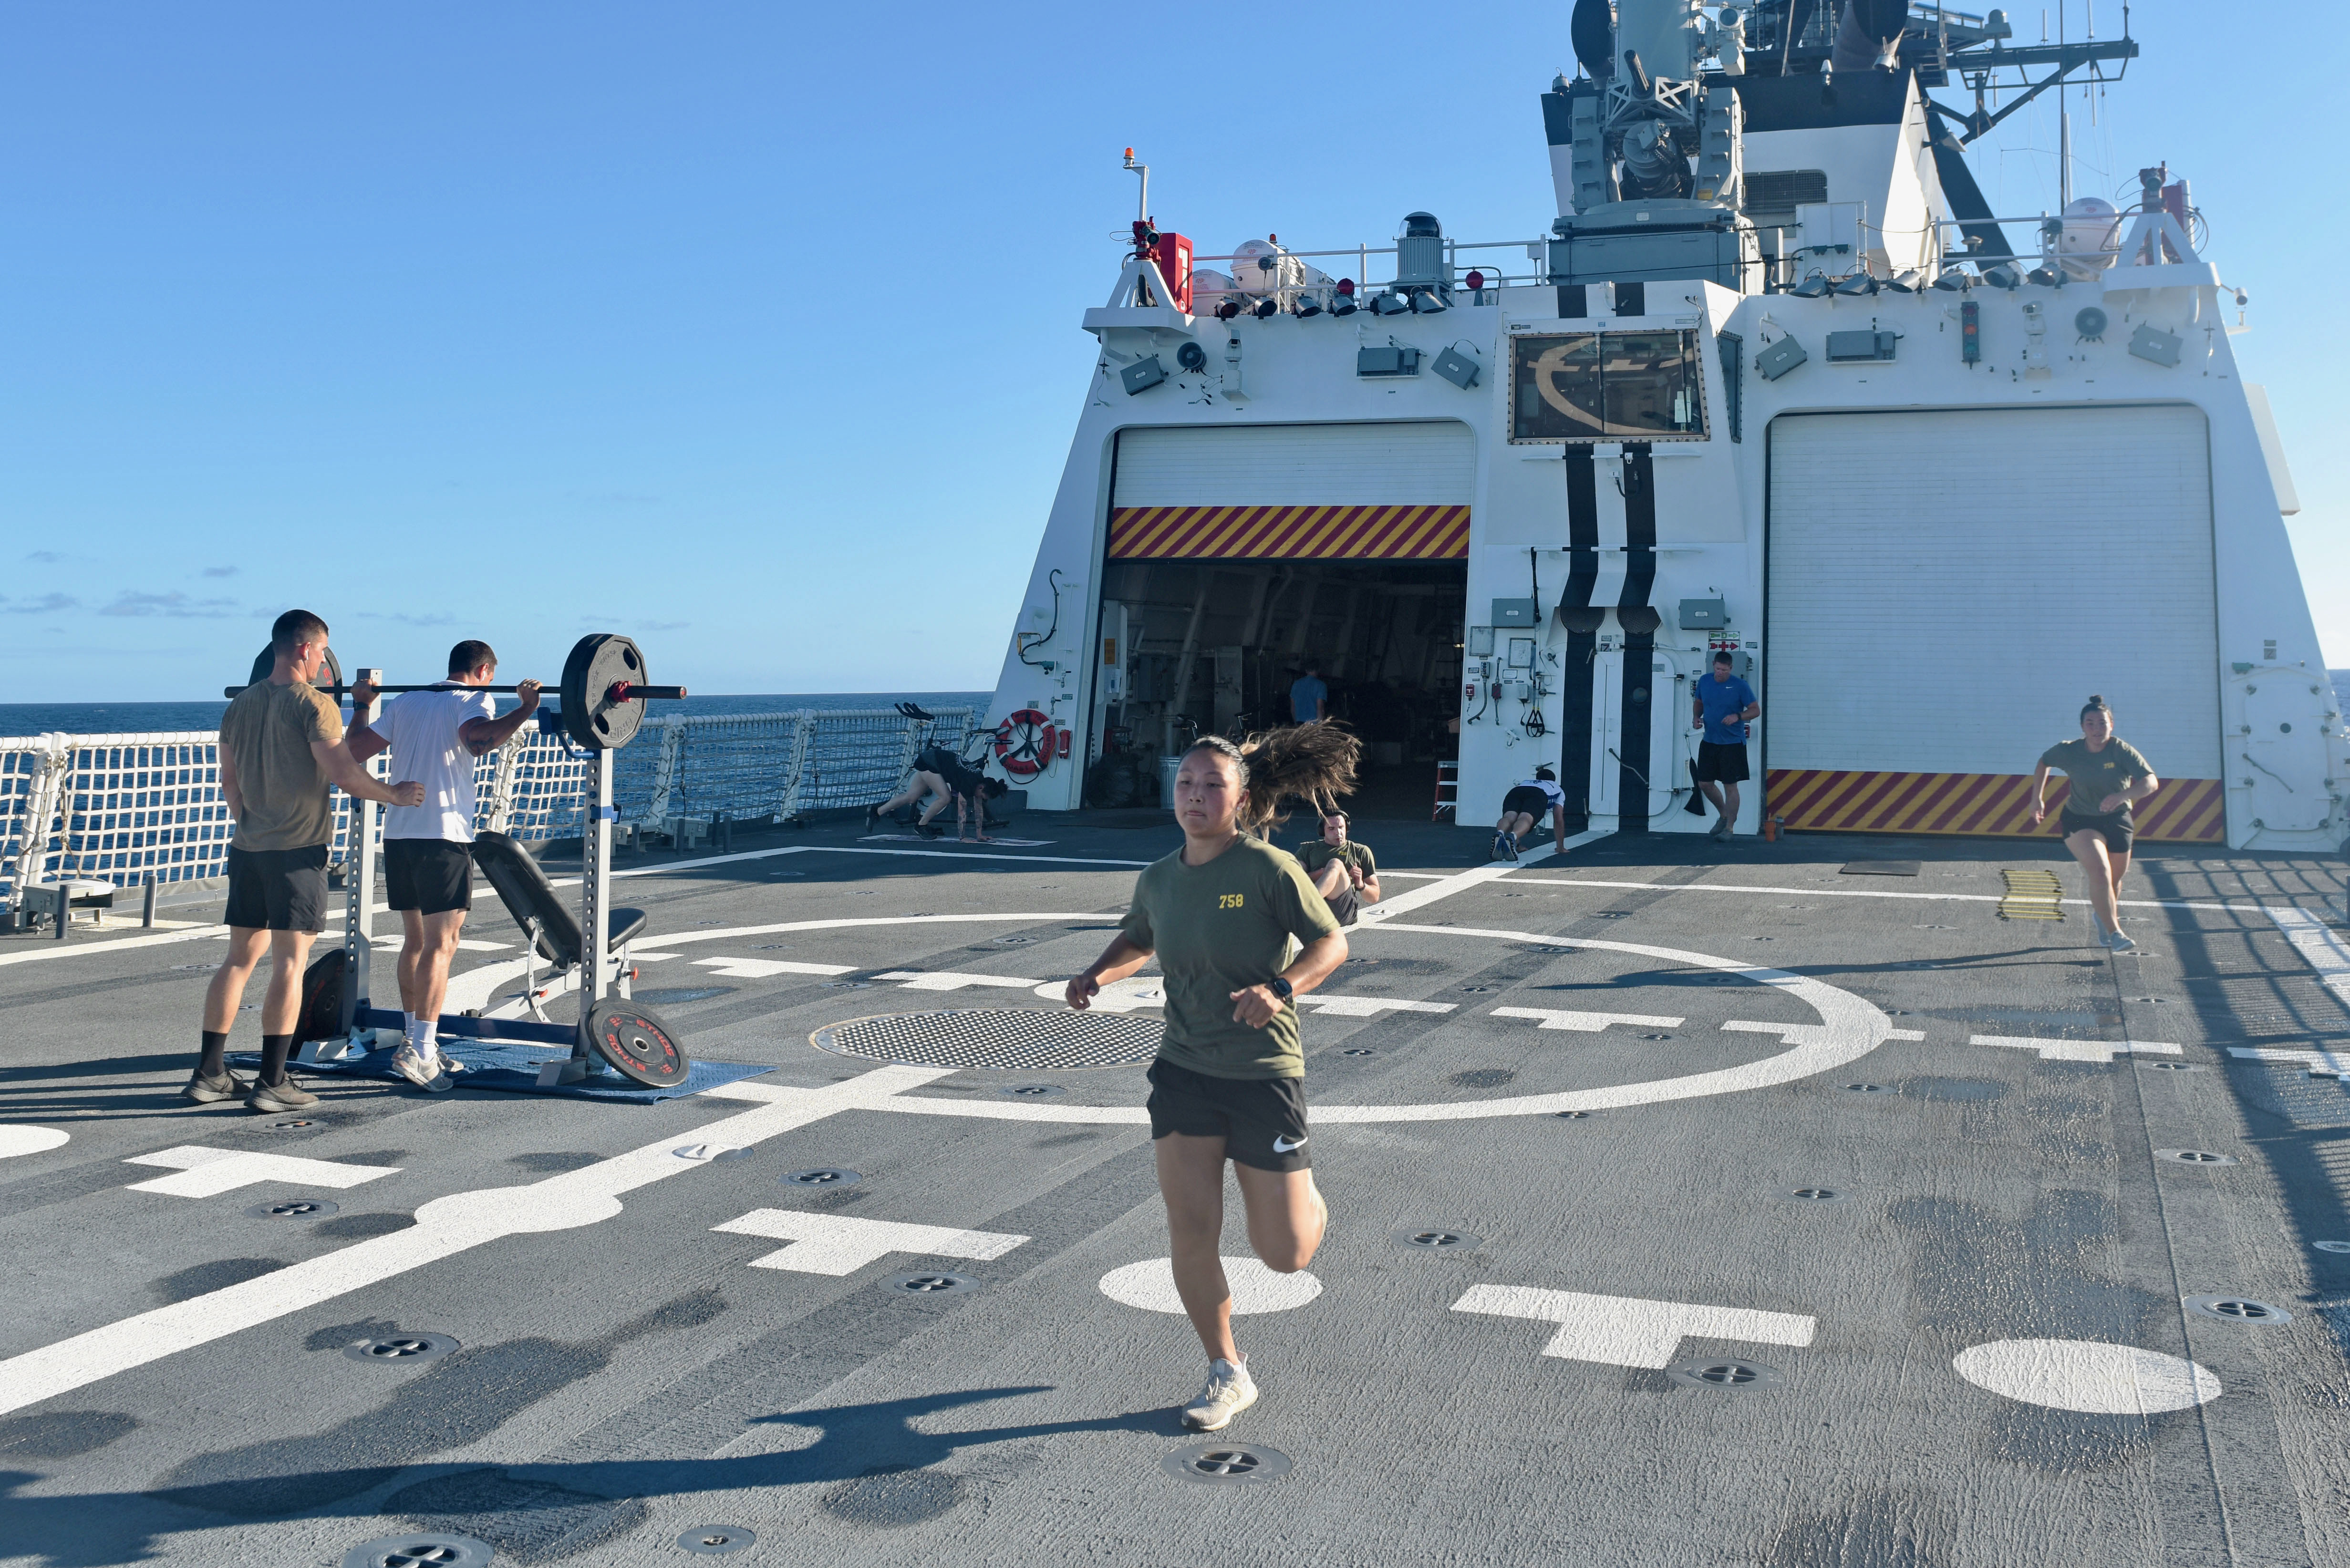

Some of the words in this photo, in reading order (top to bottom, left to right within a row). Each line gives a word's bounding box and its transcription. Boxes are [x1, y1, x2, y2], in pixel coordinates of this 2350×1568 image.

[610, 717, 633, 738] GRIP
[1041, 731, 1051, 760] GUARD
[1219, 894, 1243, 908] 758
[607, 1033, 646, 1072] ETHOS
[636, 1019, 675, 1057] ETHOS
